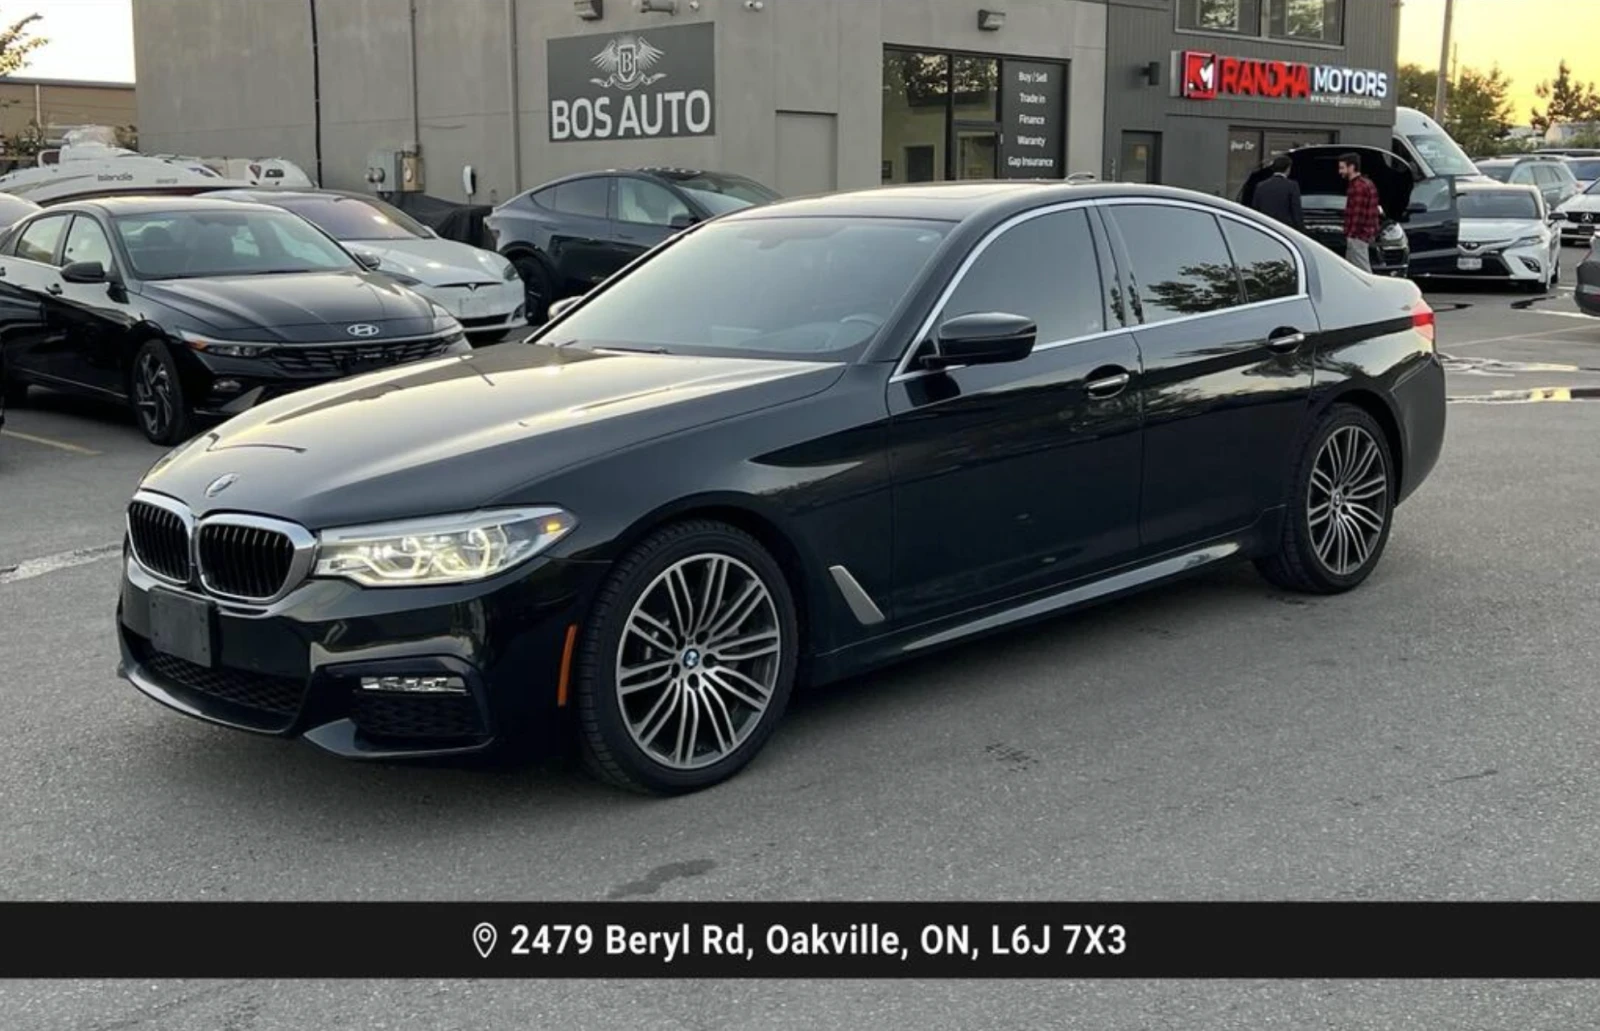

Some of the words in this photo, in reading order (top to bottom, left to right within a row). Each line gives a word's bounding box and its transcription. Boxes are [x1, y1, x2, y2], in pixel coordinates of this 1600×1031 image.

[622, 51, 632, 73] B
[1018, 71, 1032, 83] Buy
[1035, 72, 1048, 83] Sell
[1314, 65, 1388, 98] MOTORS
[1019, 92, 1039, 103] Trade
[551, 97, 613, 139] BOS
[617, 89, 711, 136] AUTO
[1018, 113, 1046, 125] Finance
[1007, 156, 1022, 168] Gap
[1021, 156, 1054, 167] Insurance
